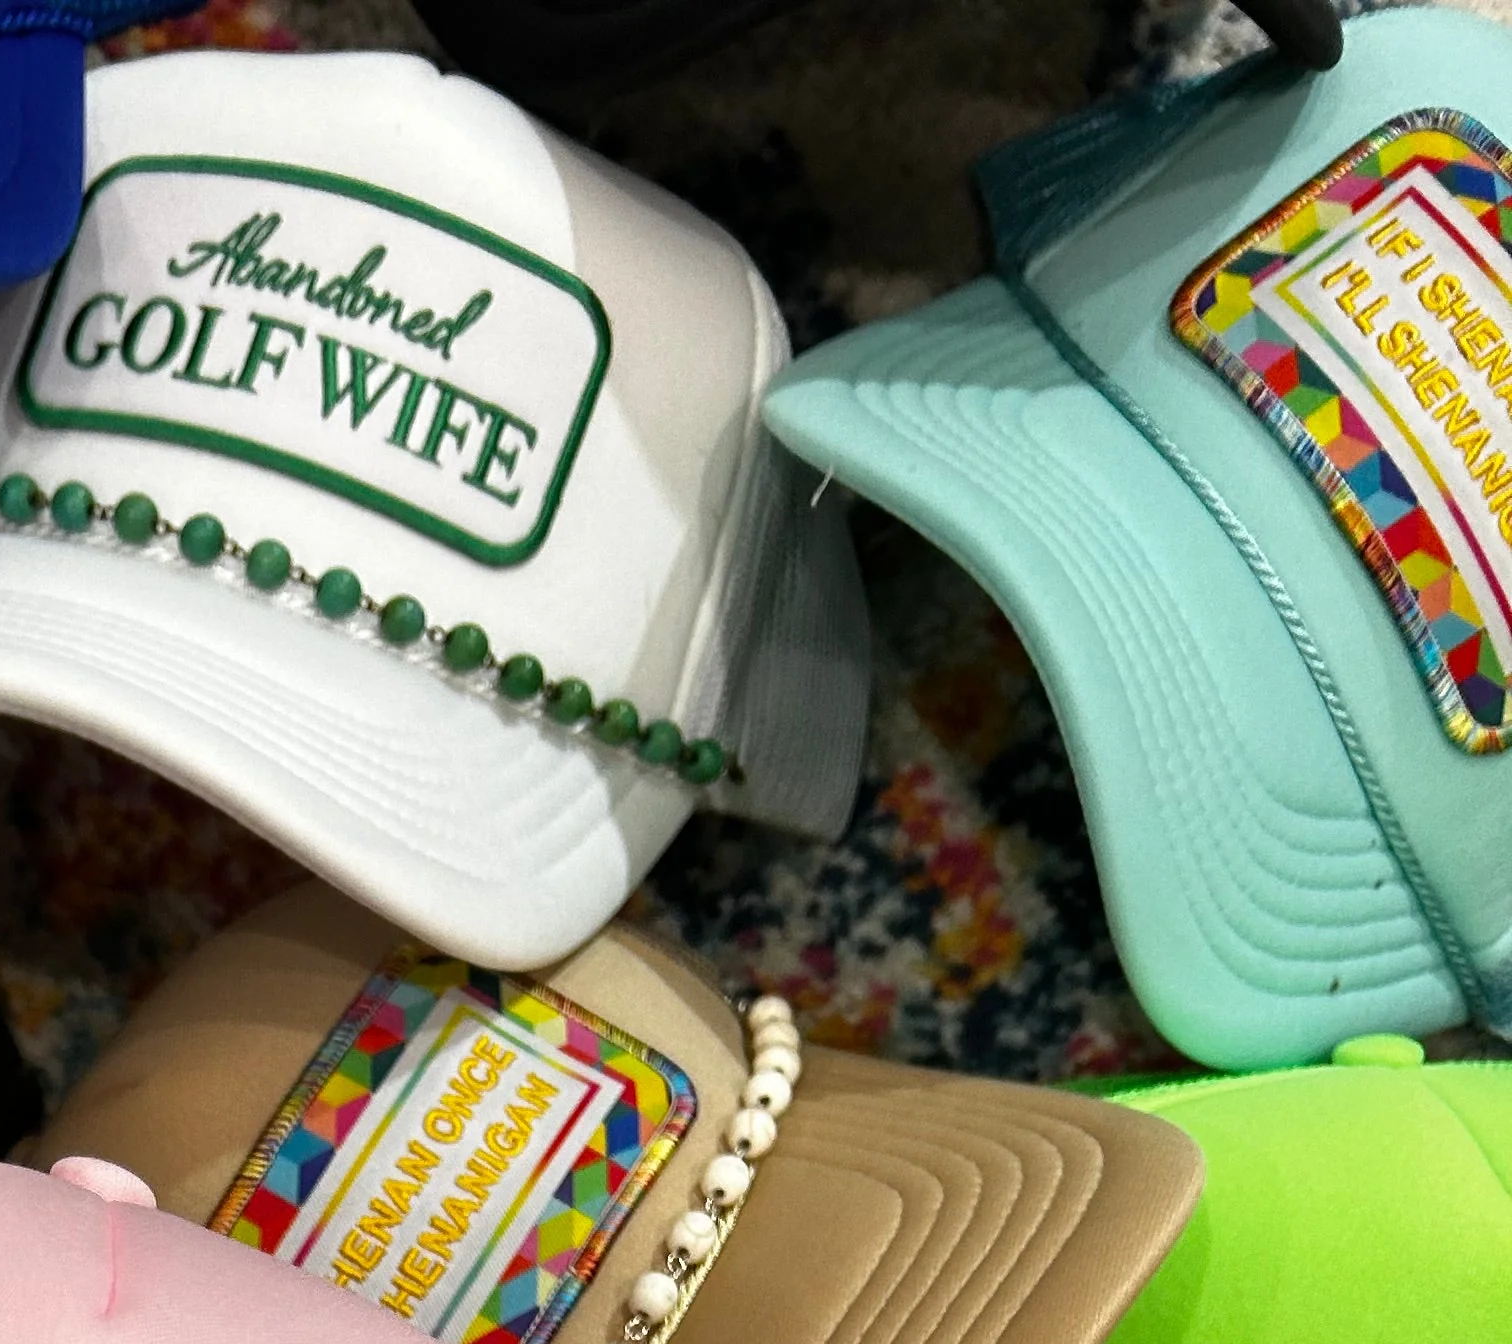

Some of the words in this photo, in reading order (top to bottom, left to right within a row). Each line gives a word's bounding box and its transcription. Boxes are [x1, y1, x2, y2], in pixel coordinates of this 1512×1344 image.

[168, 212, 493, 362] Abandoned
[1320, 260, 1390, 337] I'LL
[1366, 216, 1425, 258] IF
[1400, 253, 1436, 284] I
[64, 292, 305, 395] GOLF
[316, 333, 538, 508] WIFE
[329, 1138, 441, 1288] HENAN
[424, 1034, 517, 1144] ONCE
[380, 1072, 560, 1319] HENANIGAN
